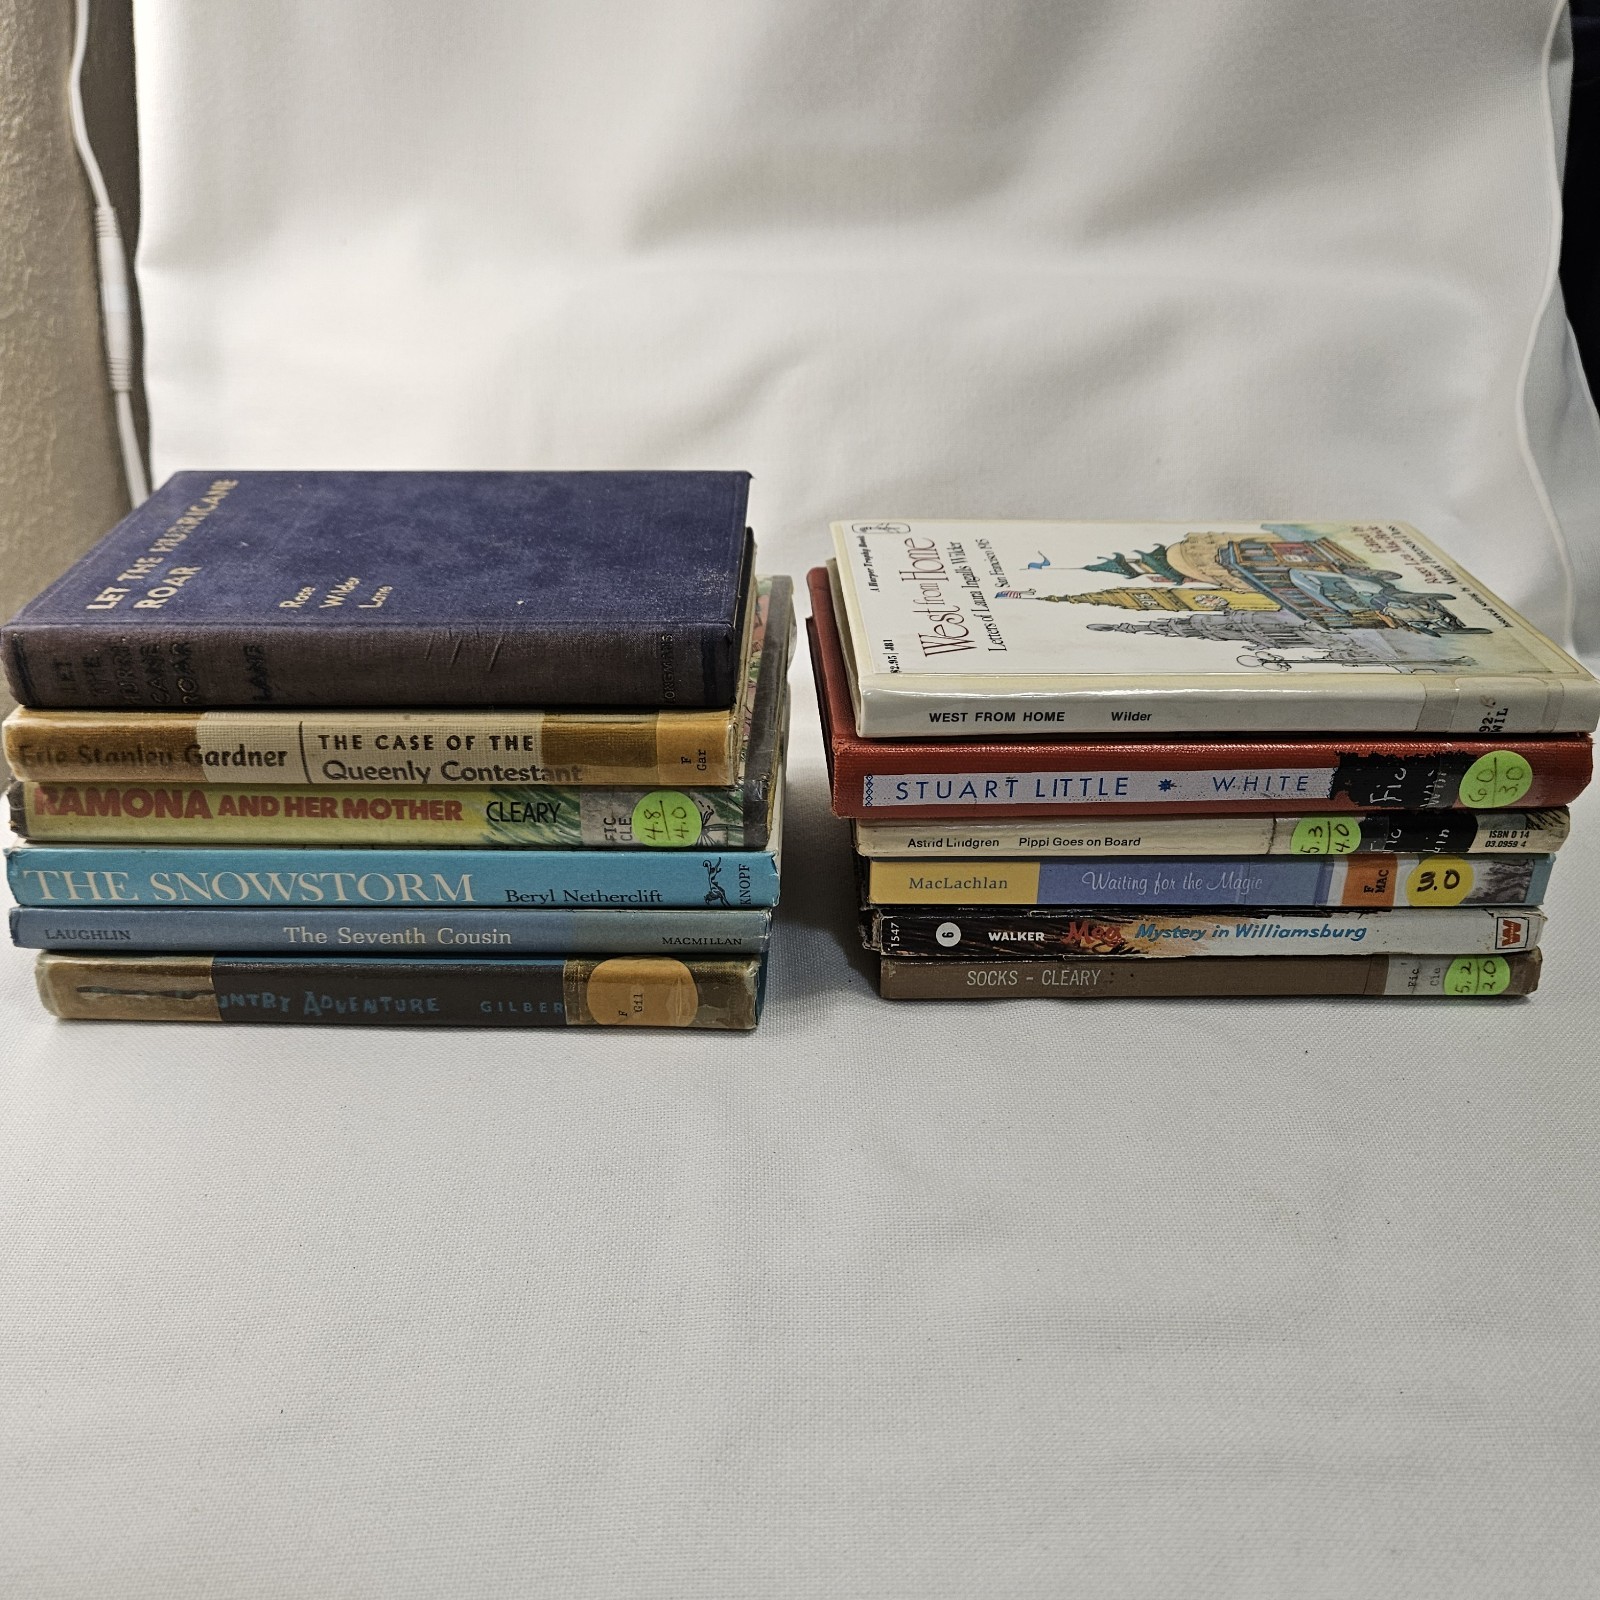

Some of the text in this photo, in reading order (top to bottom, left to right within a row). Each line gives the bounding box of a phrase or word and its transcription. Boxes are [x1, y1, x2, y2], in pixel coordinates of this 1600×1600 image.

[85, 478, 239, 610] LET THE HURRICANE
[134, 566, 202, 609] ROAR
[319, 576, 361, 609] Wilder
[995, 576, 1010, 588] San
[279, 586, 317, 608] Rose
[357, 585, 394, 609] Lane
[899, 537, 977, 658] West from Home
[947, 541, 1008, 652] Letters of Laura Ingalls Wilder
[888, 655, 901, 674] $2.95
[929, 711, 1152, 723] WEST FROM HOME Wilder
[1491, 707, 1508, 733] WIL
[318, 734, 533, 751] THE CASE OF THE
[185, 743, 288, 767] Gardner
[681, 756, 691, 764] F
[697, 749, 706, 771] Gar
[322, 760, 583, 784] Queenly Contestant
[1499, 766, 1524, 797] 3.0
[896, 776, 1309, 800] STUART LITTLE WHITE
[1370, 767, 1406, 804] Fic
[34, 787, 464, 821] RAMONA AND HER MOTHER
[486, 801, 561, 823] CLEARY
[603, 817, 616, 841] FIC
[618, 817, 633, 841] CLE
[644, 808, 663, 841] 4.8
[671, 806, 689, 839] 4.0
[907, 836, 1141, 850] Astrid Lindgren Pippi Goes on Board
[1301, 826, 1323, 853] 5.3
[1334, 824, 1350, 853] 4.0
[1489, 831, 1510, 839] ISBN
[23, 870, 477, 902] THE SNOWSTORM
[739, 863, 752, 905] KNOPF
[909, 871, 1263, 899] MacLachlan Waiting for the Magic
[1364, 885, 1374, 893] F
[1375, 869, 1389, 893] MAC
[1417, 869, 1460, 892] 3.0
[505, 889, 663, 905] Beryl Netherclift
[45, 926, 512, 945] LAUGHLIN The Seventh Cousin
[661, 937, 742, 945] MACMILLAN
[890, 922, 900, 947] 1547
[988, 921, 1367, 947] WALKER Meg Mystery in Williamsburg
[967, 970, 1018, 986] SOCKS
[1041, 969, 1101, 986] CLEARY
[1408, 967, 1419, 988] Fic
[218, 991, 440, 1017] UNTRY ADVENTURE
[480, 1000, 574, 1013] GILBER
